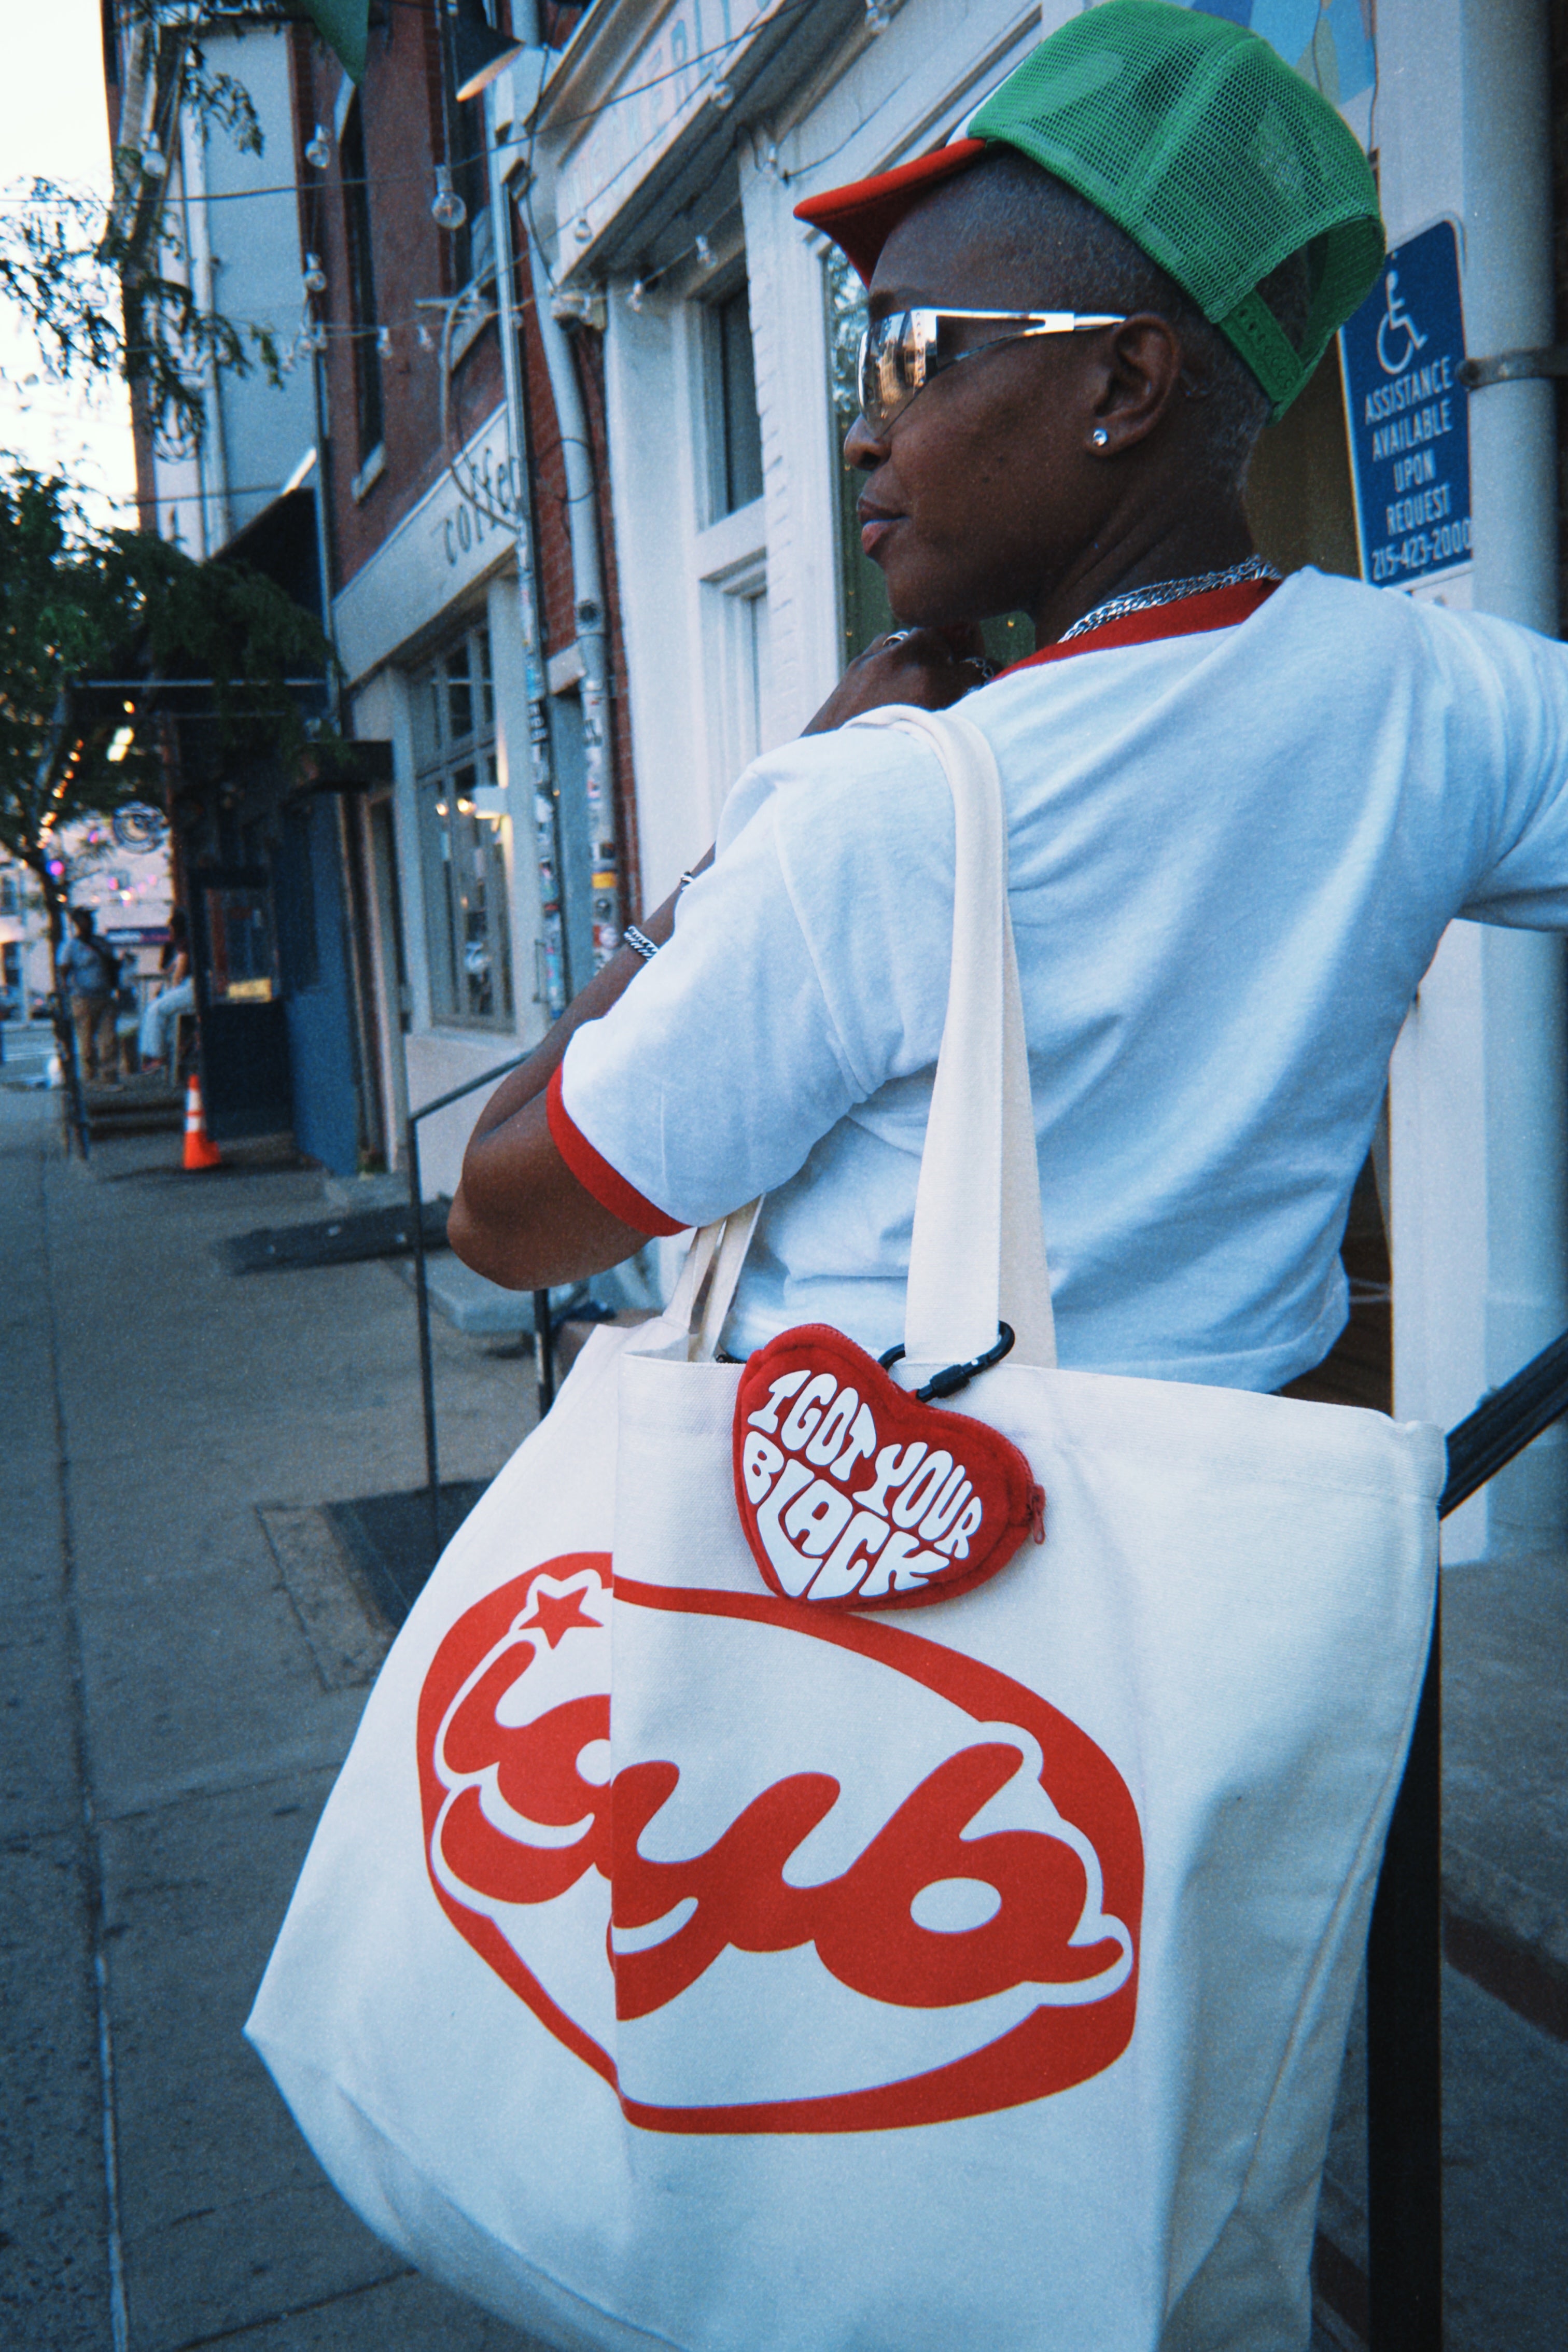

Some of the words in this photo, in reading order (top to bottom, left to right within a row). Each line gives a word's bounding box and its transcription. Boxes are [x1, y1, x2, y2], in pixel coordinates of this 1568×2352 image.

[1365, 357, 1452, 424] ASSISTANCE
[1373, 398, 1452, 462] AVAILABLE
[1393, 448, 1436, 493] UPON
[1386, 483, 1451, 536] REQUEST
[1371, 516, 1471, 581] 215-423-2000
[747, 1370, 811, 1433] I
[780, 1373, 876, 1481] GOT
[743, 1431, 950, 1600] BLACK
[852, 1442, 982, 1560] YOUR
